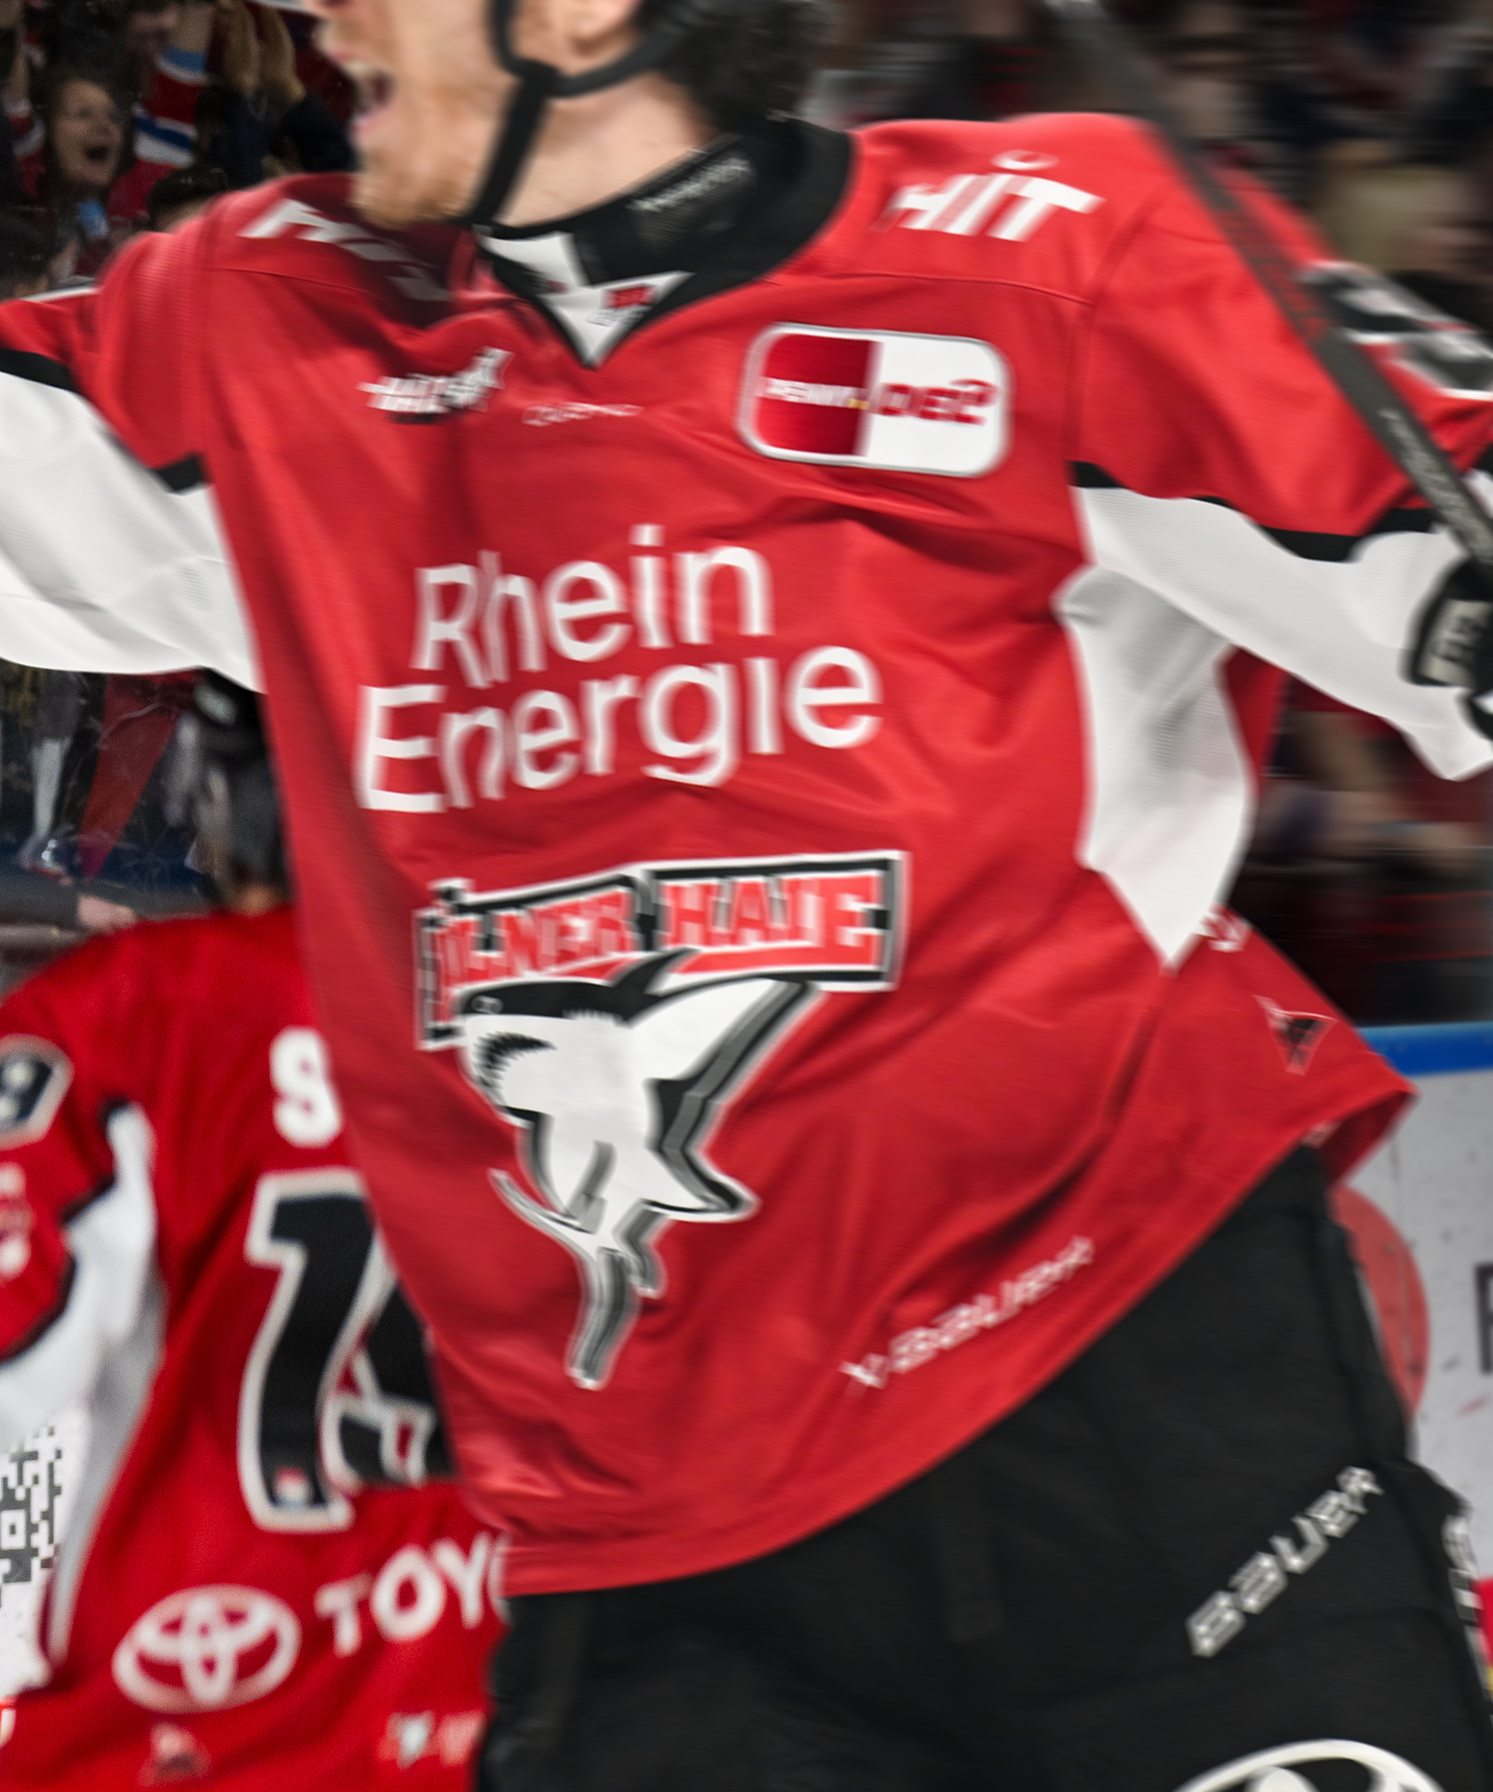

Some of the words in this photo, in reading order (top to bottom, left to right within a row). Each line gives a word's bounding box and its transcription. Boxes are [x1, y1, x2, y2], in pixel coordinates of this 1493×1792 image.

[413, 522, 775, 690] Rhein
[355, 645, 883, 812] Energie
[1186, 1465, 1384, 1657] BAUER
